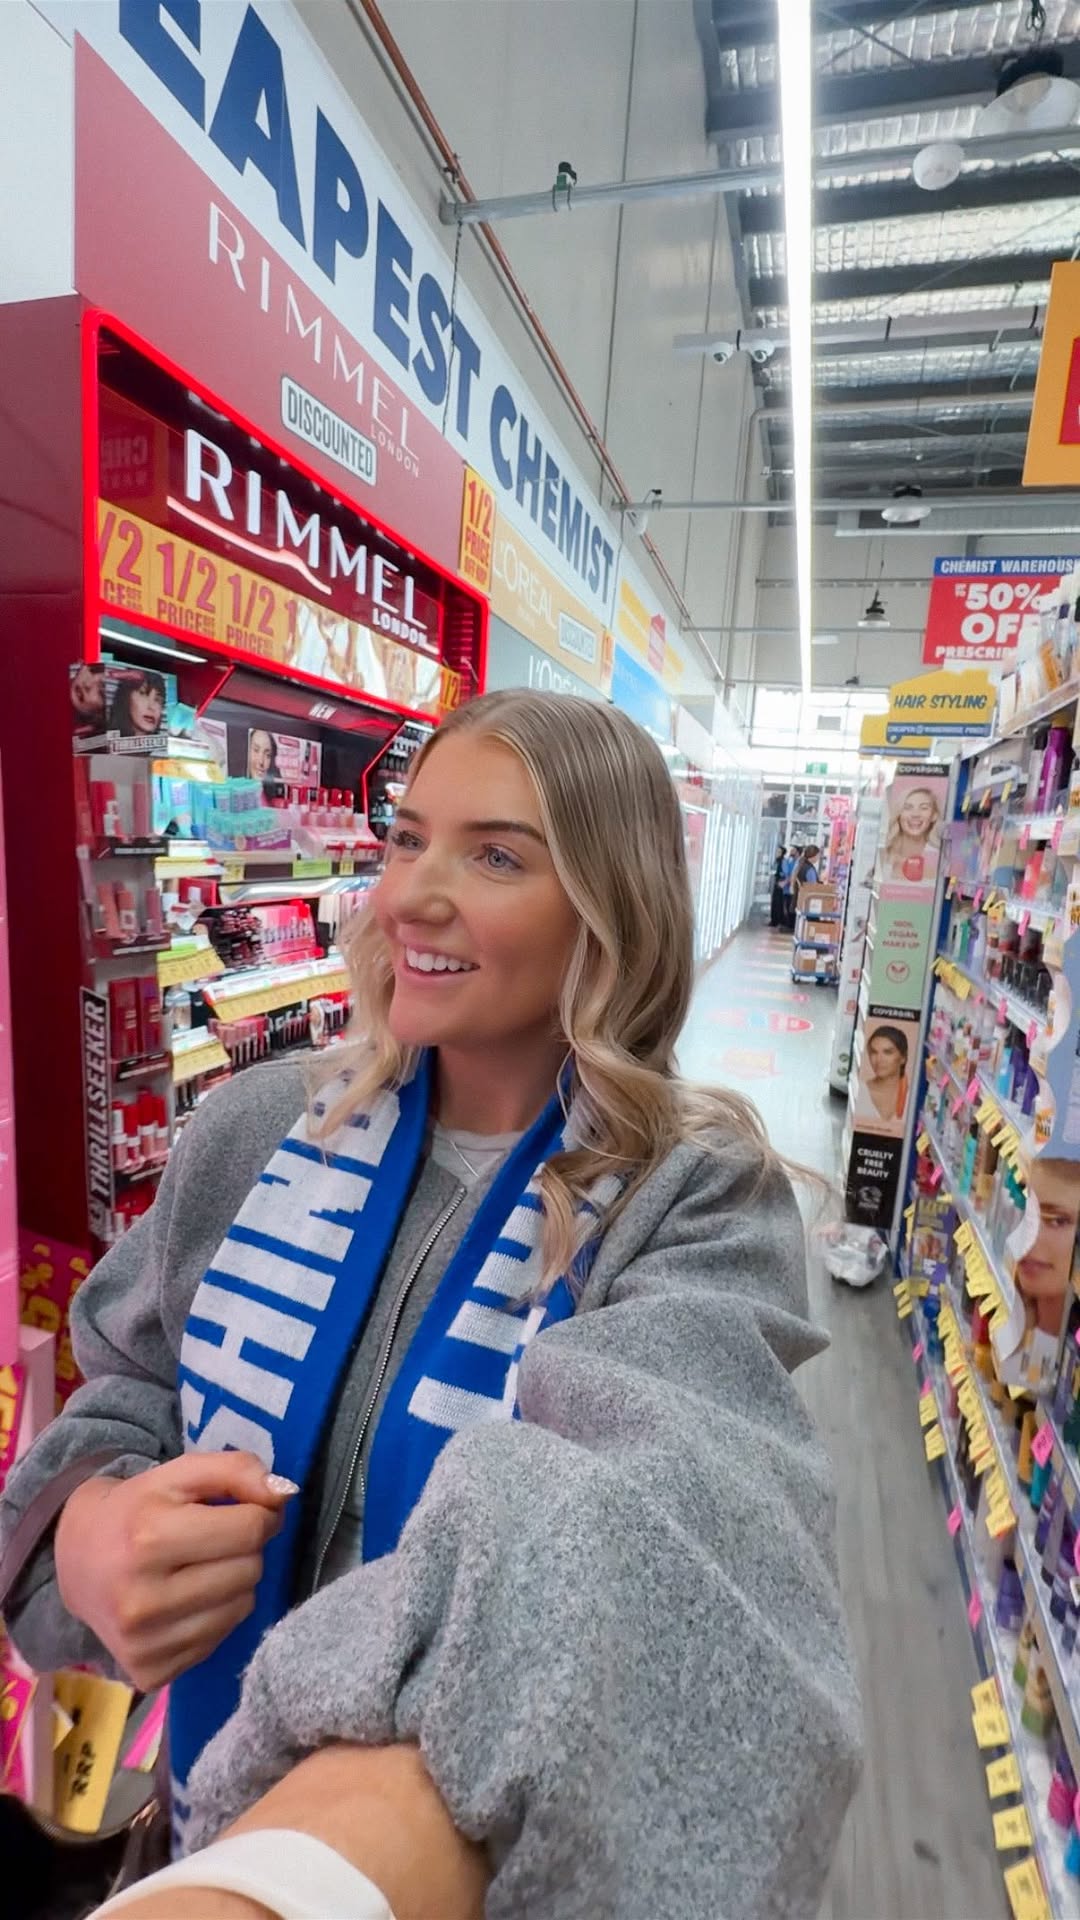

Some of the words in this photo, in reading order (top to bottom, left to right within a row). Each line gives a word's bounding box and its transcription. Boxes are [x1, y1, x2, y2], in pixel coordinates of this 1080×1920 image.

[208, 201, 419, 460] RIMMEL
[286, 390, 374, 478] DISCOUNTED
[370, 423, 419, 479] LONDON
[468, 480, 493, 539] 1/2
[489, 384, 614, 604] CHEMIST
[183, 428, 428, 631] RIMMEL
[156, 541, 218, 614] 1/2
[940, 559, 997, 574] CHEMIST
[1001, 558, 1074, 574] WAREHOUS
[227, 572, 276, 637] 1/2
[965, 582, 1041, 611] 50%
[372, 607, 428, 648] LONDON
[894, 694, 927, 709] HAIR
[929, 694, 988, 709] STYLING
[898, 764, 945, 775] COVERGIRL
[872, 1007, 916, 1020] COVERGIRL
[856, 1166, 890, 1180] BEAUTY
[857, 1147, 894, 1161] CRUELTY
[864, 1158, 884, 1169] FREE
